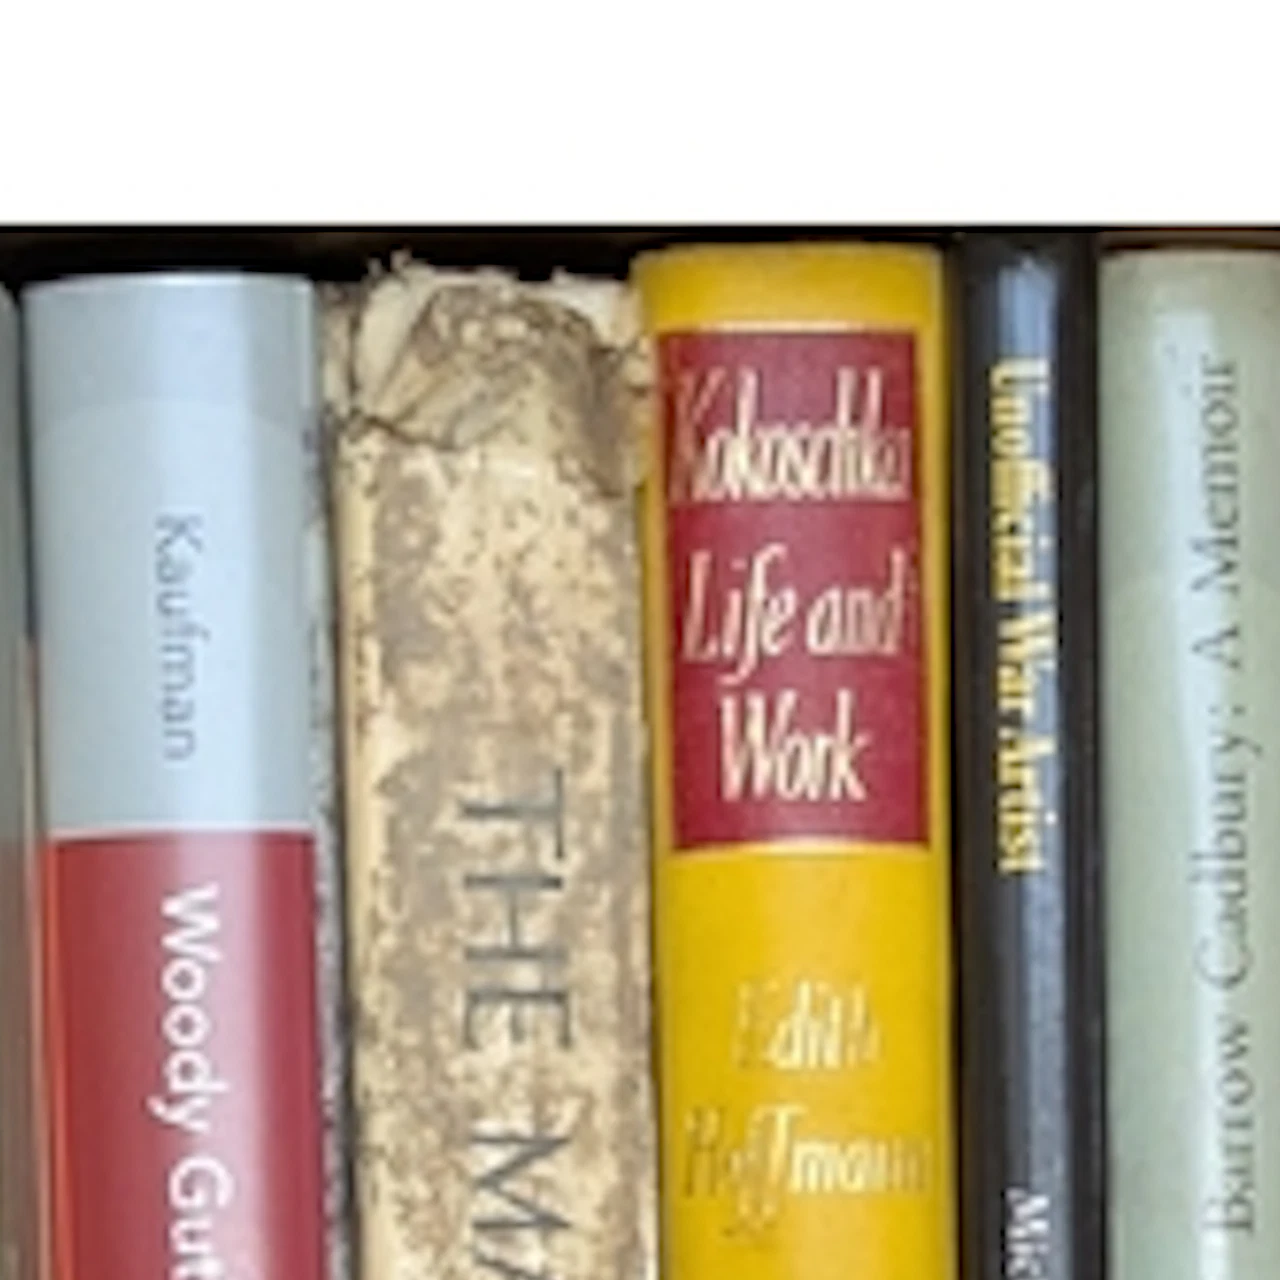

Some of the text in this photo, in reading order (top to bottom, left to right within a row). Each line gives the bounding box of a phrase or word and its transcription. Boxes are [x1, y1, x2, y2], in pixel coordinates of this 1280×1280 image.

[667, 365, 913, 502] Kokoschka
[154, 515, 211, 763] Kaufman
[682, 545, 910, 685] Life and
[989, 357, 1058, 873] Unofficial War Artist
[720, 690, 872, 801] Work
[1191, 355, 1261, 1234] Barrow Cadbury: A Memoir
[147, 883, 230, 1133] Woody
[458, 766, 572, 1051] THE
